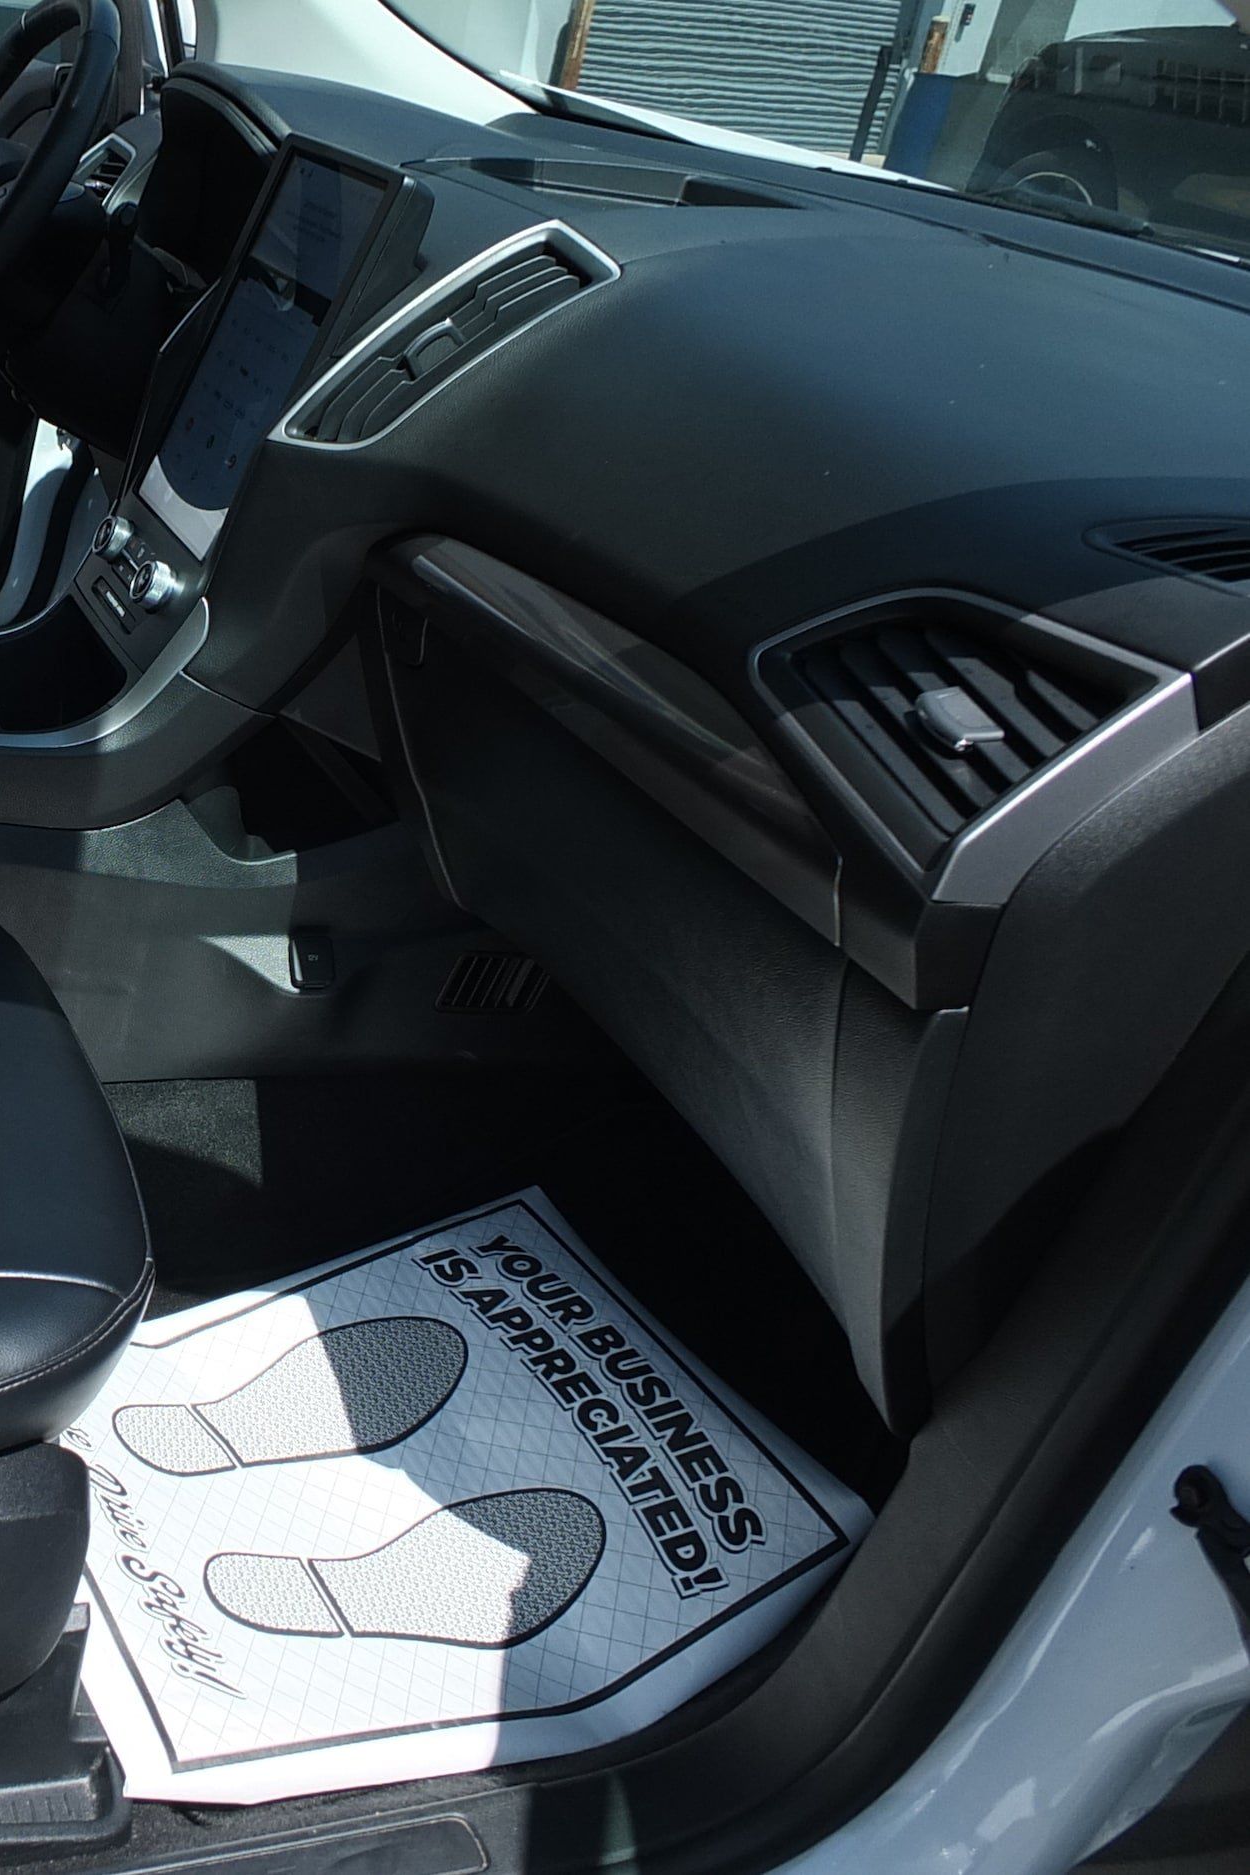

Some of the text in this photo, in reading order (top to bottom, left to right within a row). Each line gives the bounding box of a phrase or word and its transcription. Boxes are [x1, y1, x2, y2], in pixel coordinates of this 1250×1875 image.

[413, 1249, 728, 1599] IS APPRECIATED!
[472, 1234, 765, 1553] YOUR BUSINESS
[88, 1463, 245, 1698] Drive Safely!
